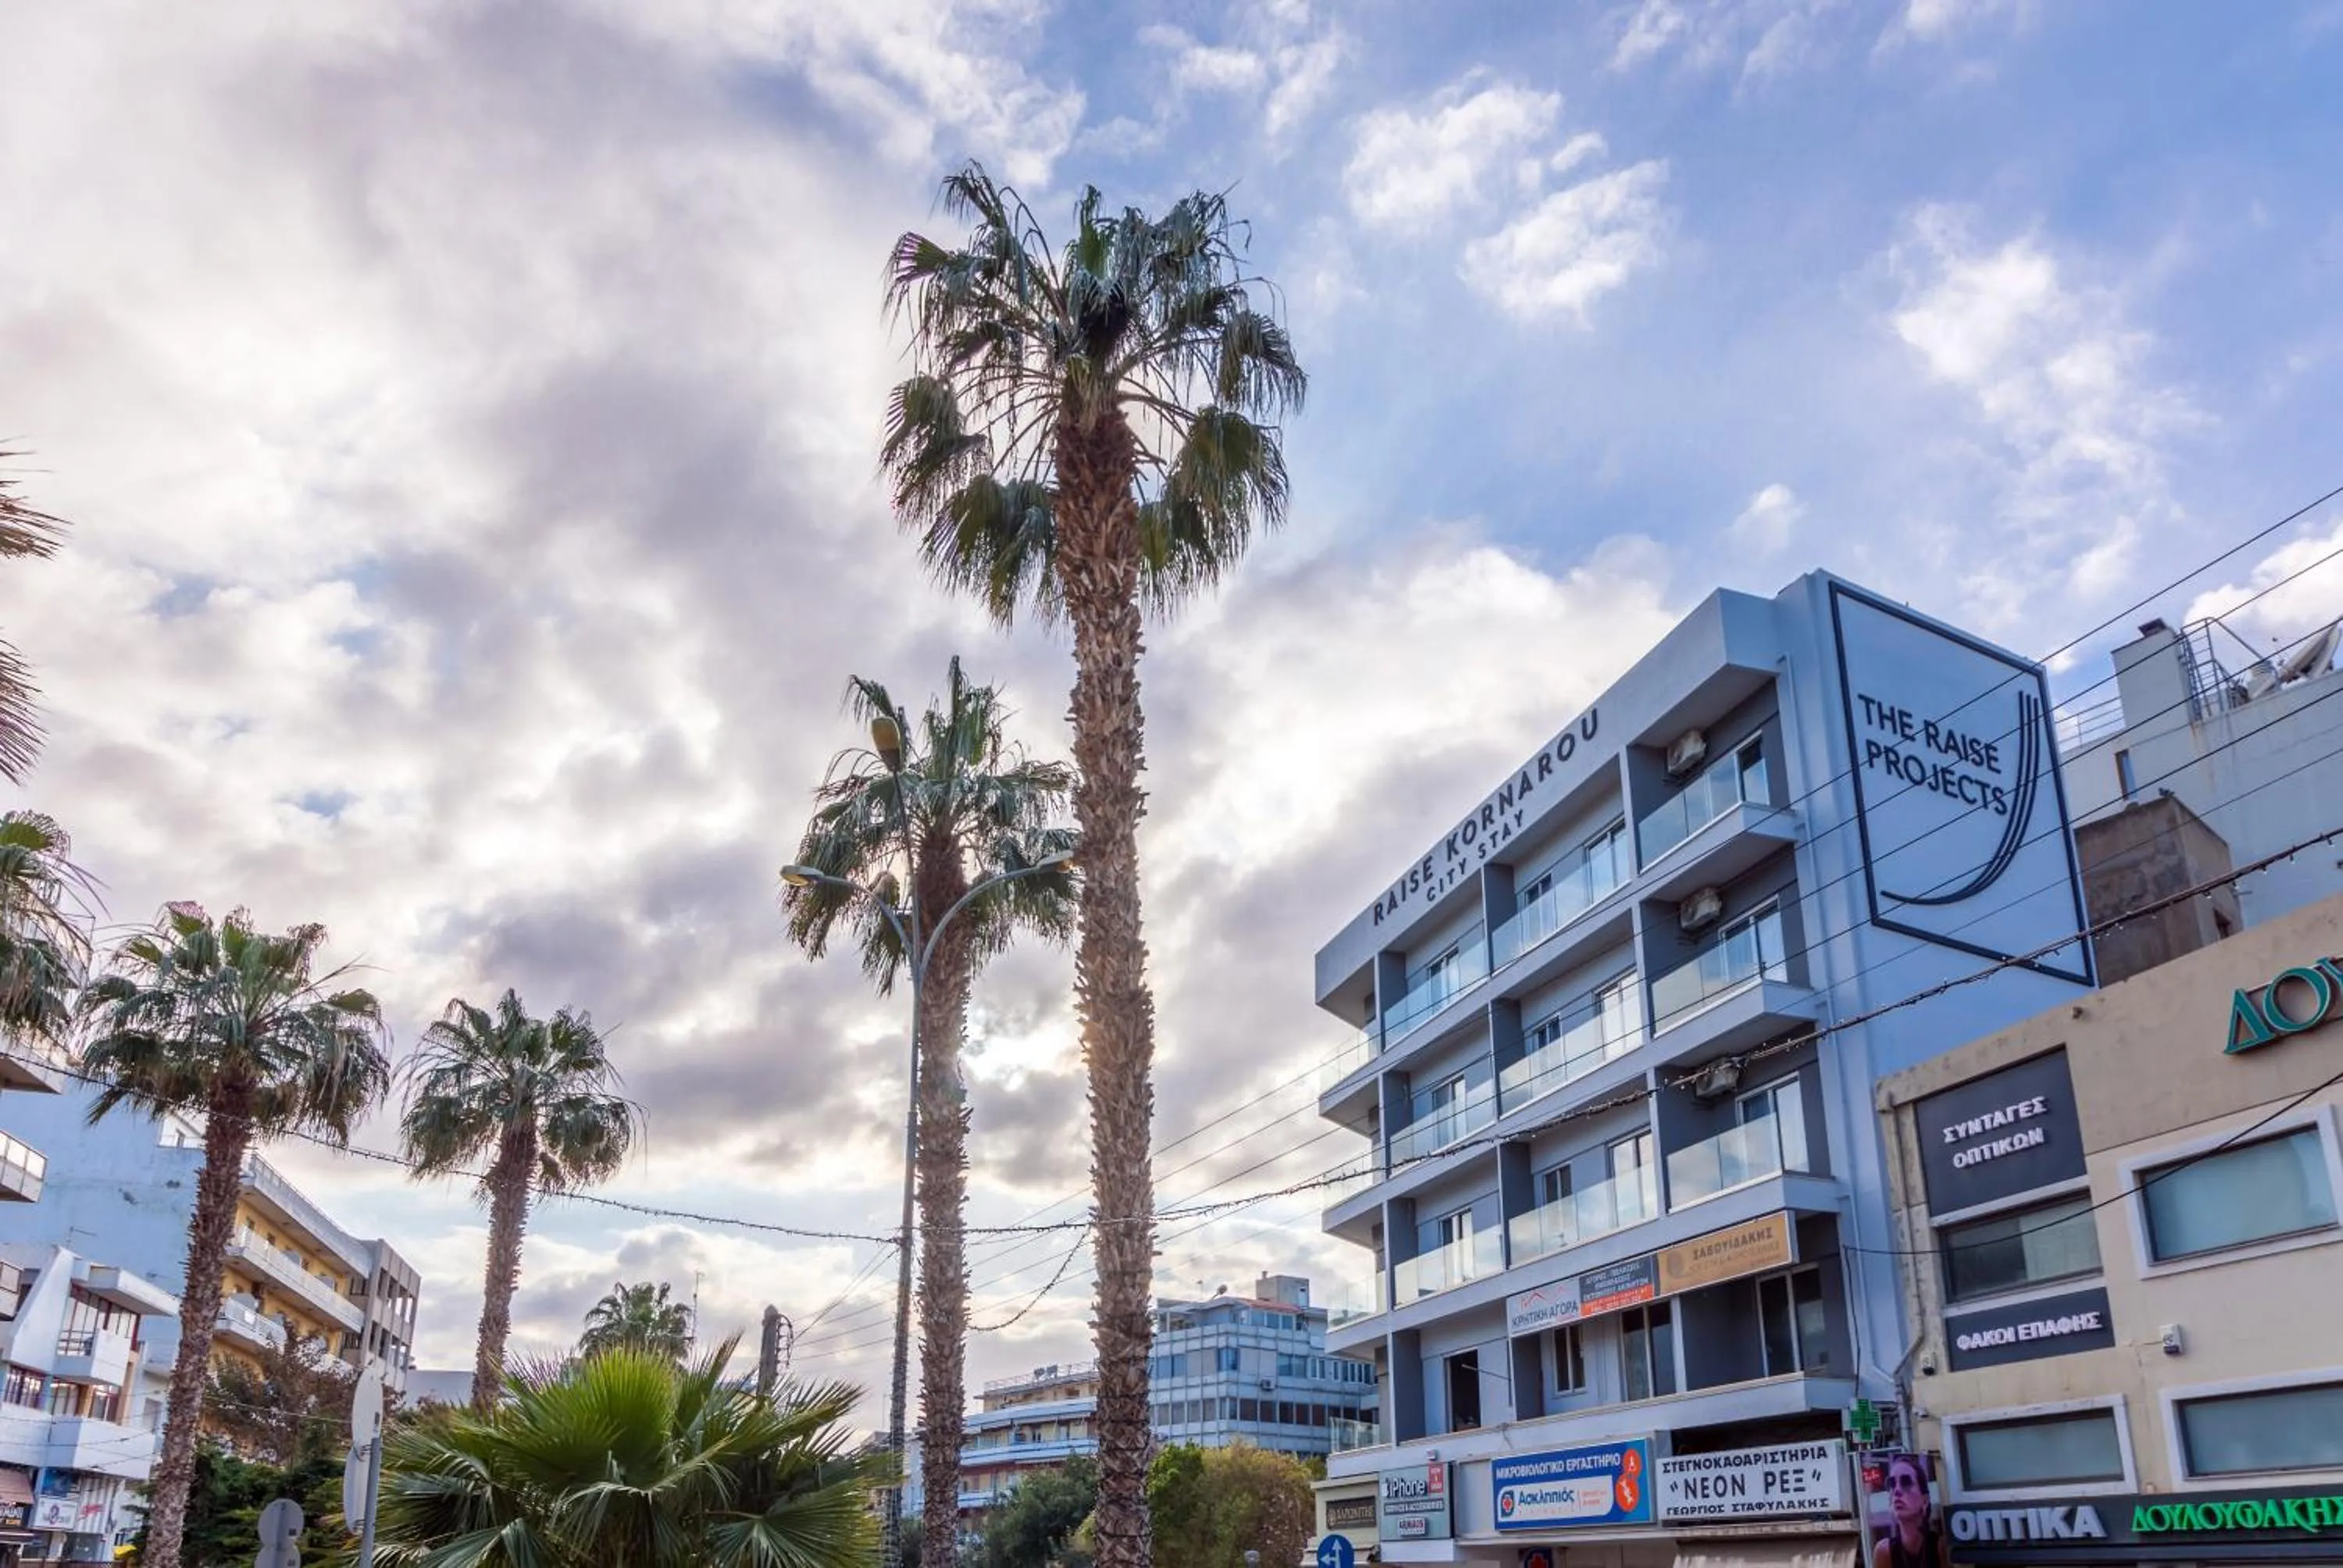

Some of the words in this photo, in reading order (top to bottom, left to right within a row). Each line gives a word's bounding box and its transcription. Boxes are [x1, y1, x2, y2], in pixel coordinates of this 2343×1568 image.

[1857, 693, 1917, 742] THE
[1924, 719, 2002, 775] RAISE
[1865, 738, 2008, 815] PROJECTS
[1374, 856, 1433, 926] RAISE
[1446, 707, 1598, 862] KORNAROU
[1427, 857, 1467, 901] CITY
[1478, 809, 1523, 859] STAY
[1942, 1096, 2048, 1143] ΣΥΝΤΑΓΕΣ
[1953, 1127, 2045, 1169] ΟΠΤΙΚΩΝ
[1549, 1299, 1578, 1319] ΑΓΟΡΑ
[1956, 1327, 2016, 1350] ΦΑΚΟΙ
[2017, 1311, 2102, 1341] ΕΠΑΦΗΣ
[1566, 1452, 1621, 1471] ΕΡΓΑΣΤΗΡΙΟ
[1662, 1445, 1828, 1474] ΣΤΕΓΝΟΚΑΘΑΡΙΣΤΗΡΙΑ
[1389, 1477, 1425, 1497] iPhone
[1666, 1503, 1725, 1516] ΓΕΩΡΓΙΟΣ
[1731, 1498, 1830, 1513] ΣΤΑΦΥΛΑΚΗΣ
[1951, 1505, 2108, 1542] ΟΠΤΙΚΑ
